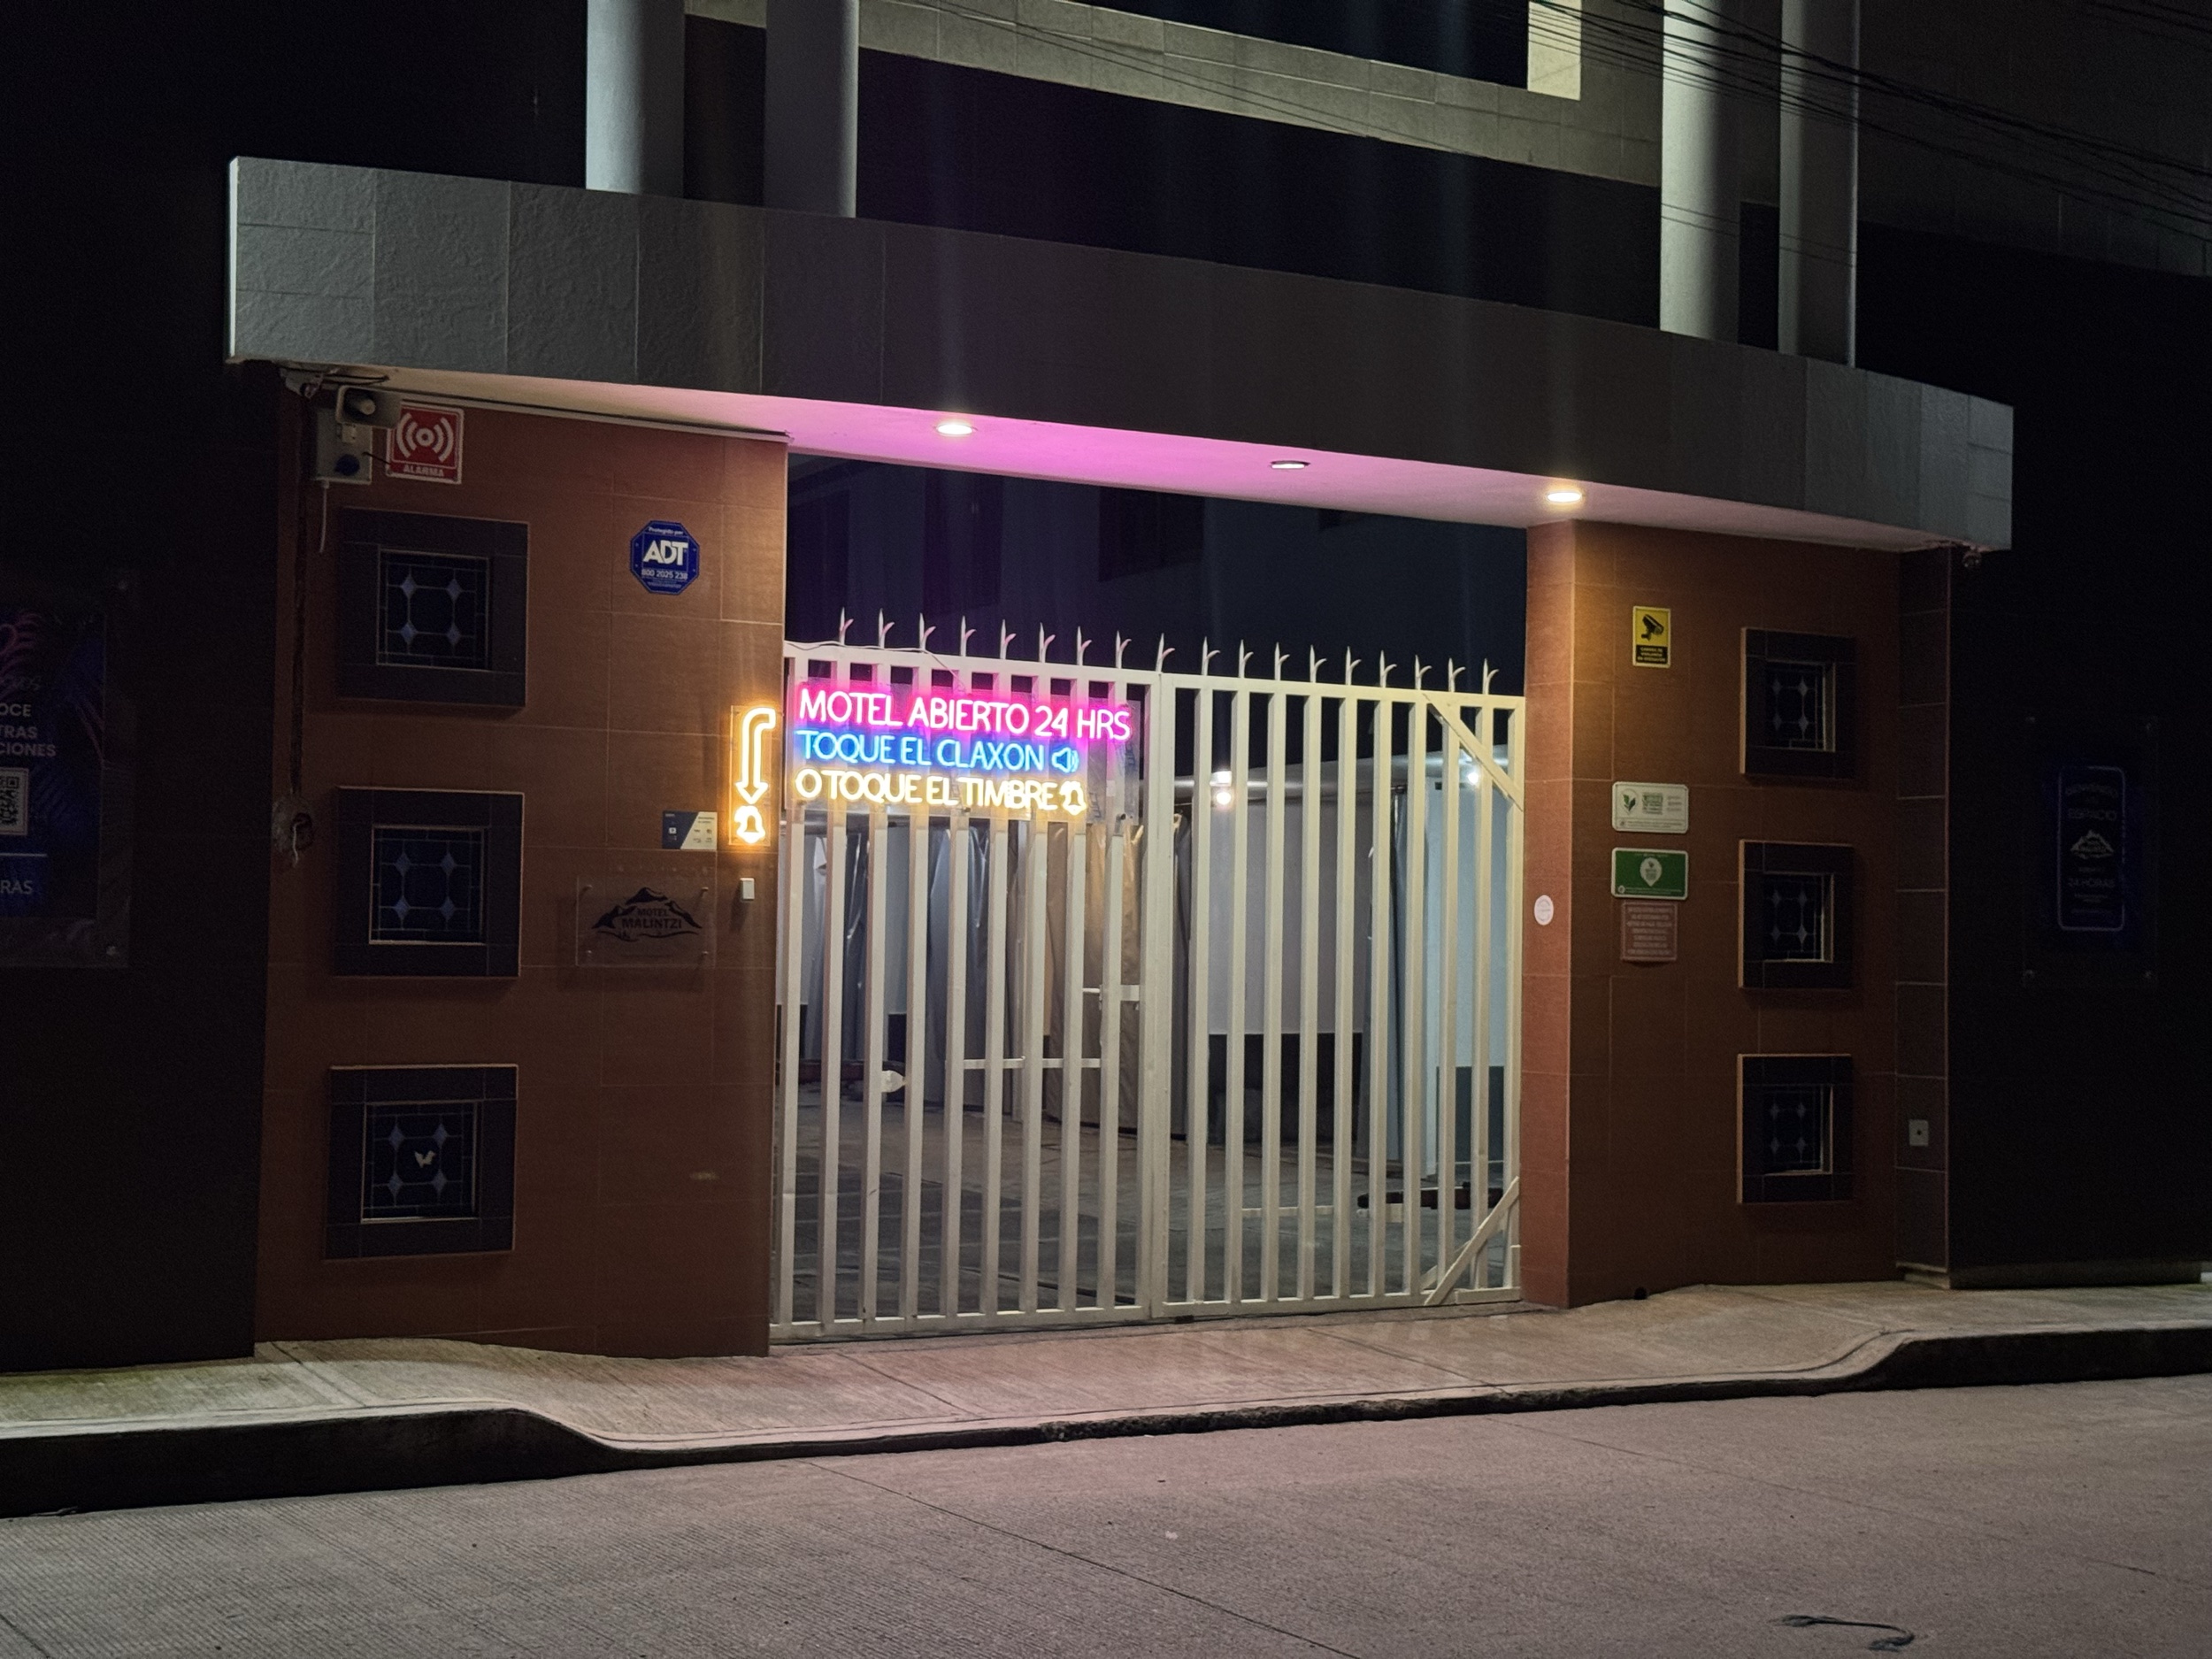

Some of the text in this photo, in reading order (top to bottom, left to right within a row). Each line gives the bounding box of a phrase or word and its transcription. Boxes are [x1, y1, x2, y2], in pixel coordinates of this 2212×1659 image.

[403, 465, 444, 477] ALARMA
[642, 540, 688, 565] ADT
[798, 688, 1132, 741] MOTEL ABIERTO 24 HRS
[796, 730, 1045, 772] TOQUE EL CLAXON
[795, 768, 1058, 810] O TOQUE EL TIMBRE
[622, 918, 682, 929] MALINTZI
[637, 908, 669, 917] MOTEL
